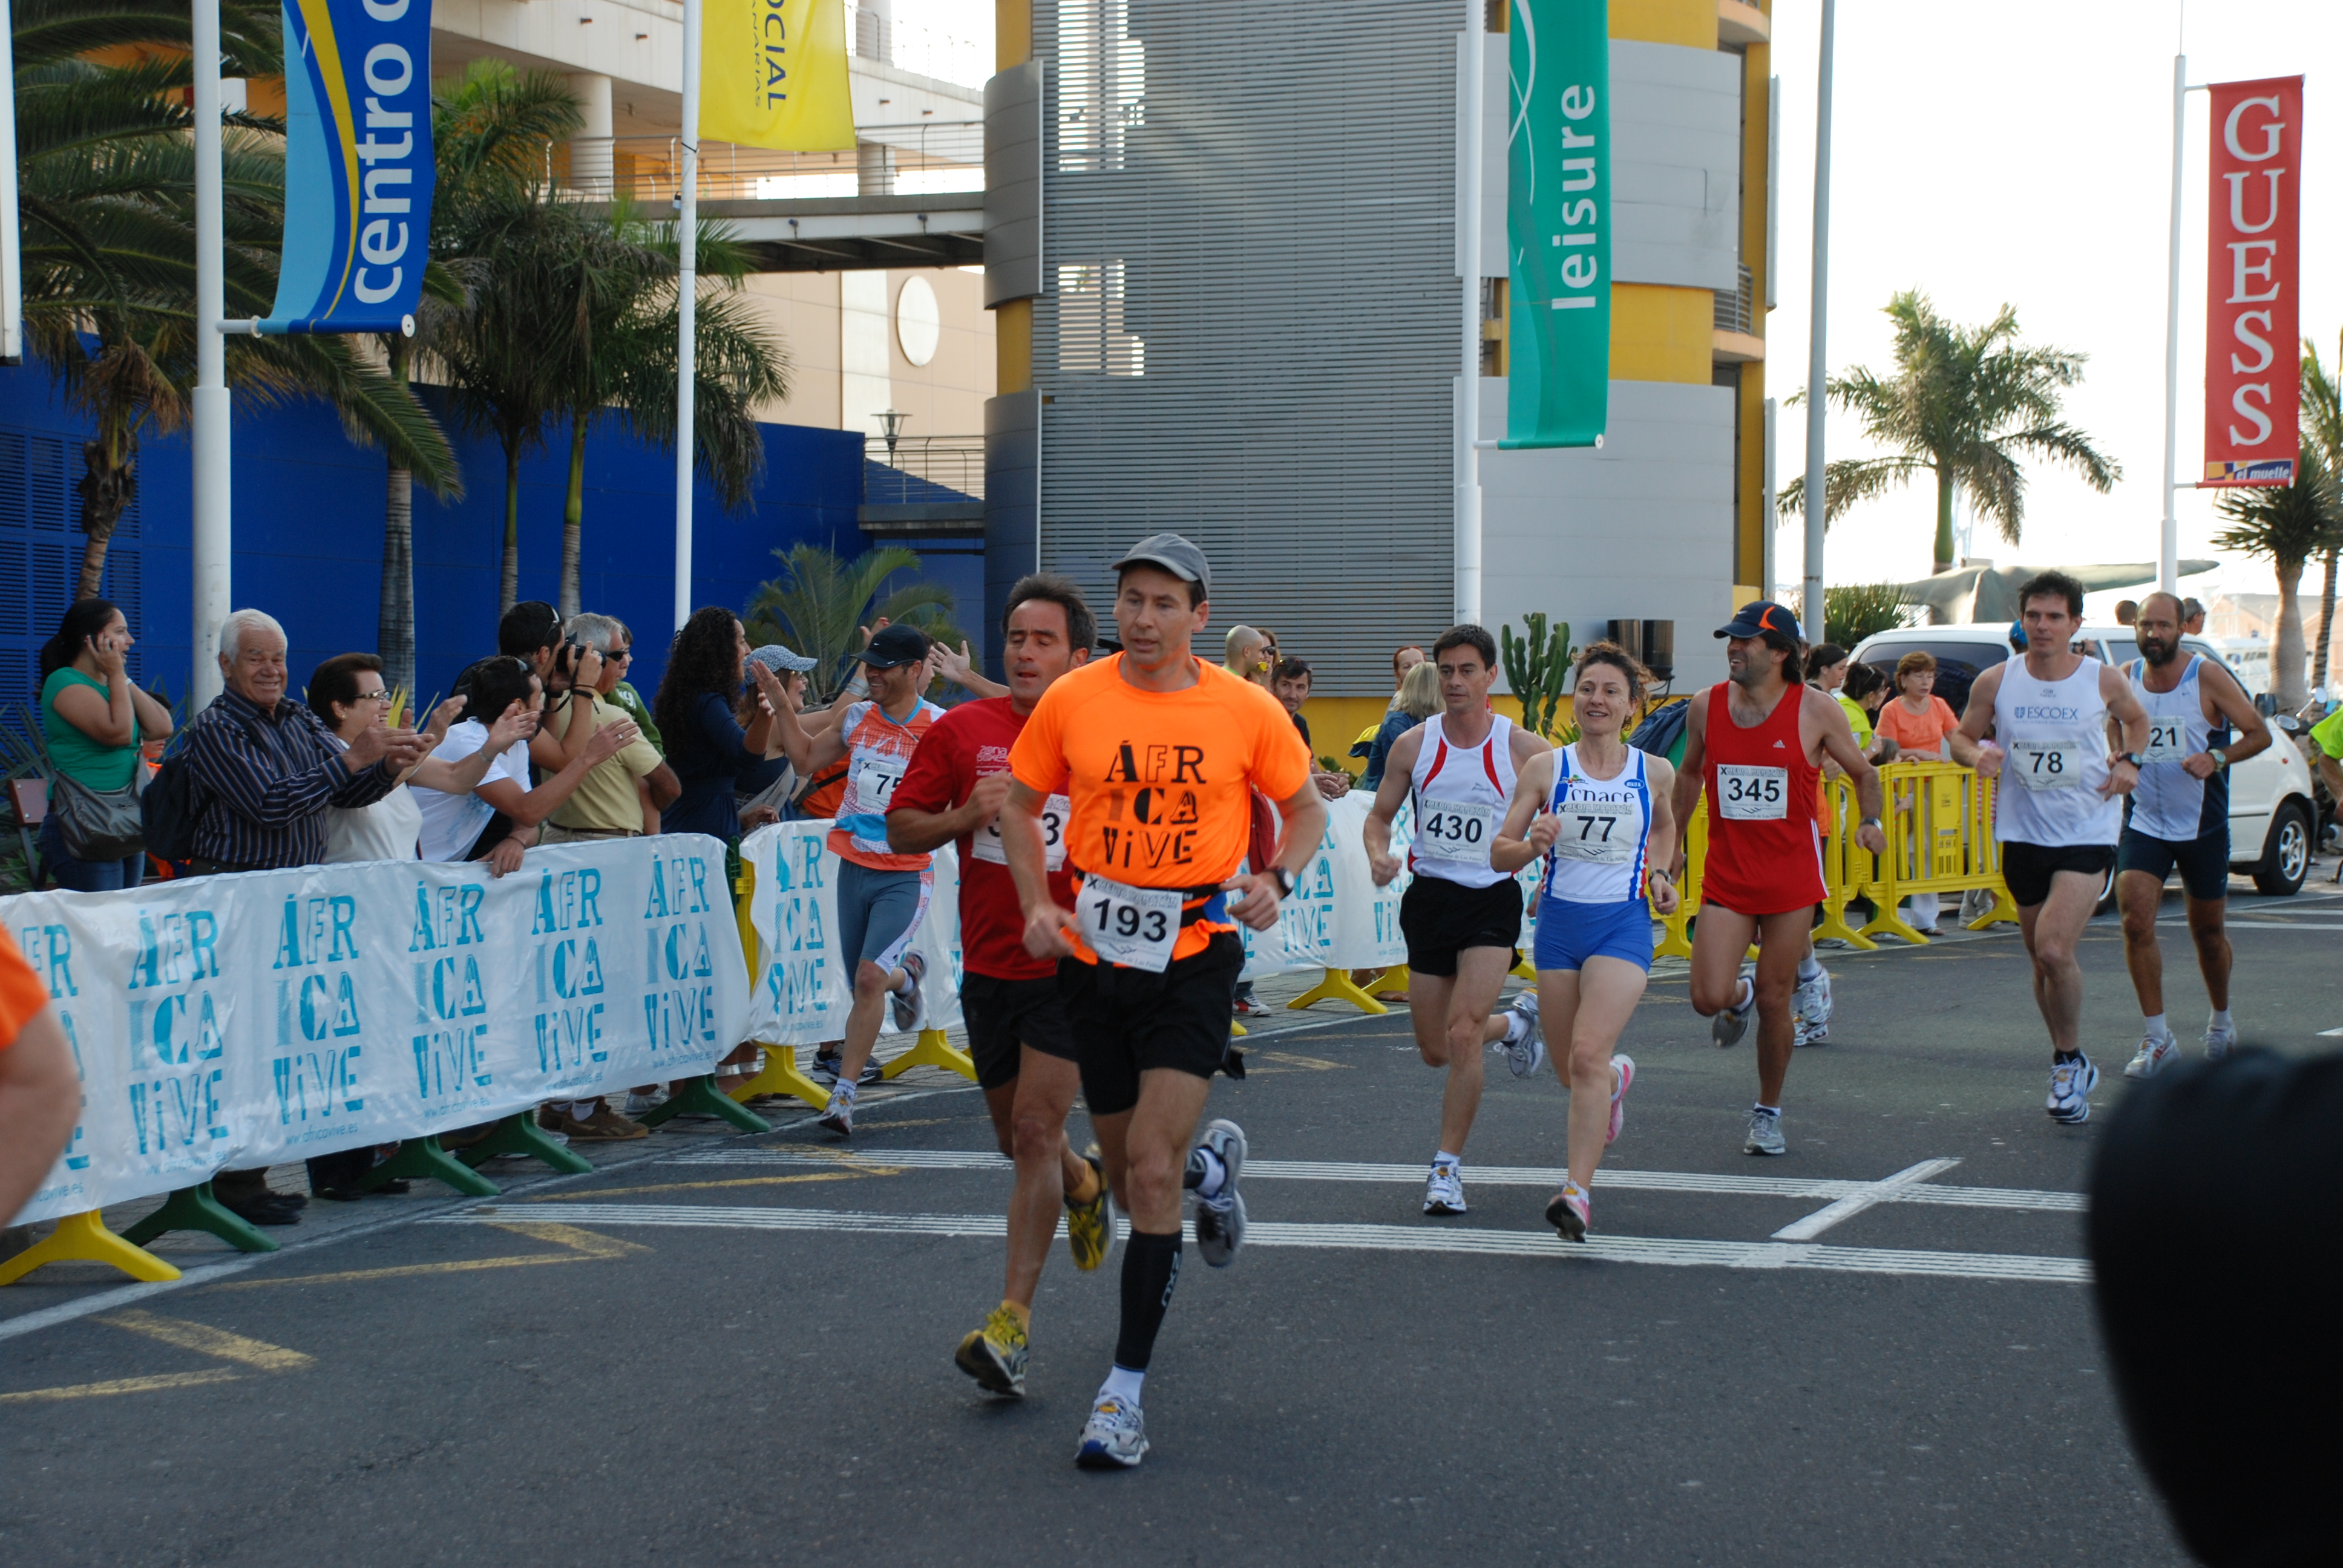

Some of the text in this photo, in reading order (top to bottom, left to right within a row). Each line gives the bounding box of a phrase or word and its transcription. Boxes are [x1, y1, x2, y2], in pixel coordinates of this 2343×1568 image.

[354, 42, 413, 304] centro
[1552, 85, 1597, 310] leisure
[2223, 95, 2286, 446] GUESS
[2236, 466, 2290, 480] el muelle
[2027, 706, 2078, 720] ESCOEX
[1104, 740, 1207, 784] ÁFR
[2030, 752, 2063, 773] 78
[1108, 787, 1198, 825] ICA
[1593, 803, 1633, 812] MARATÓN
[1728, 777, 1780, 802] 345
[1426, 812, 1482, 843] 430
[1577, 815, 1616, 842] 77
[1093, 898, 1167, 942] 193
[535, 936, 604, 1004] ICA
[645, 922, 713, 985] ICA
[274, 972, 361, 1047] ICA
[411, 954, 487, 1025] ICA
[126, 990, 223, 1073] ICA
